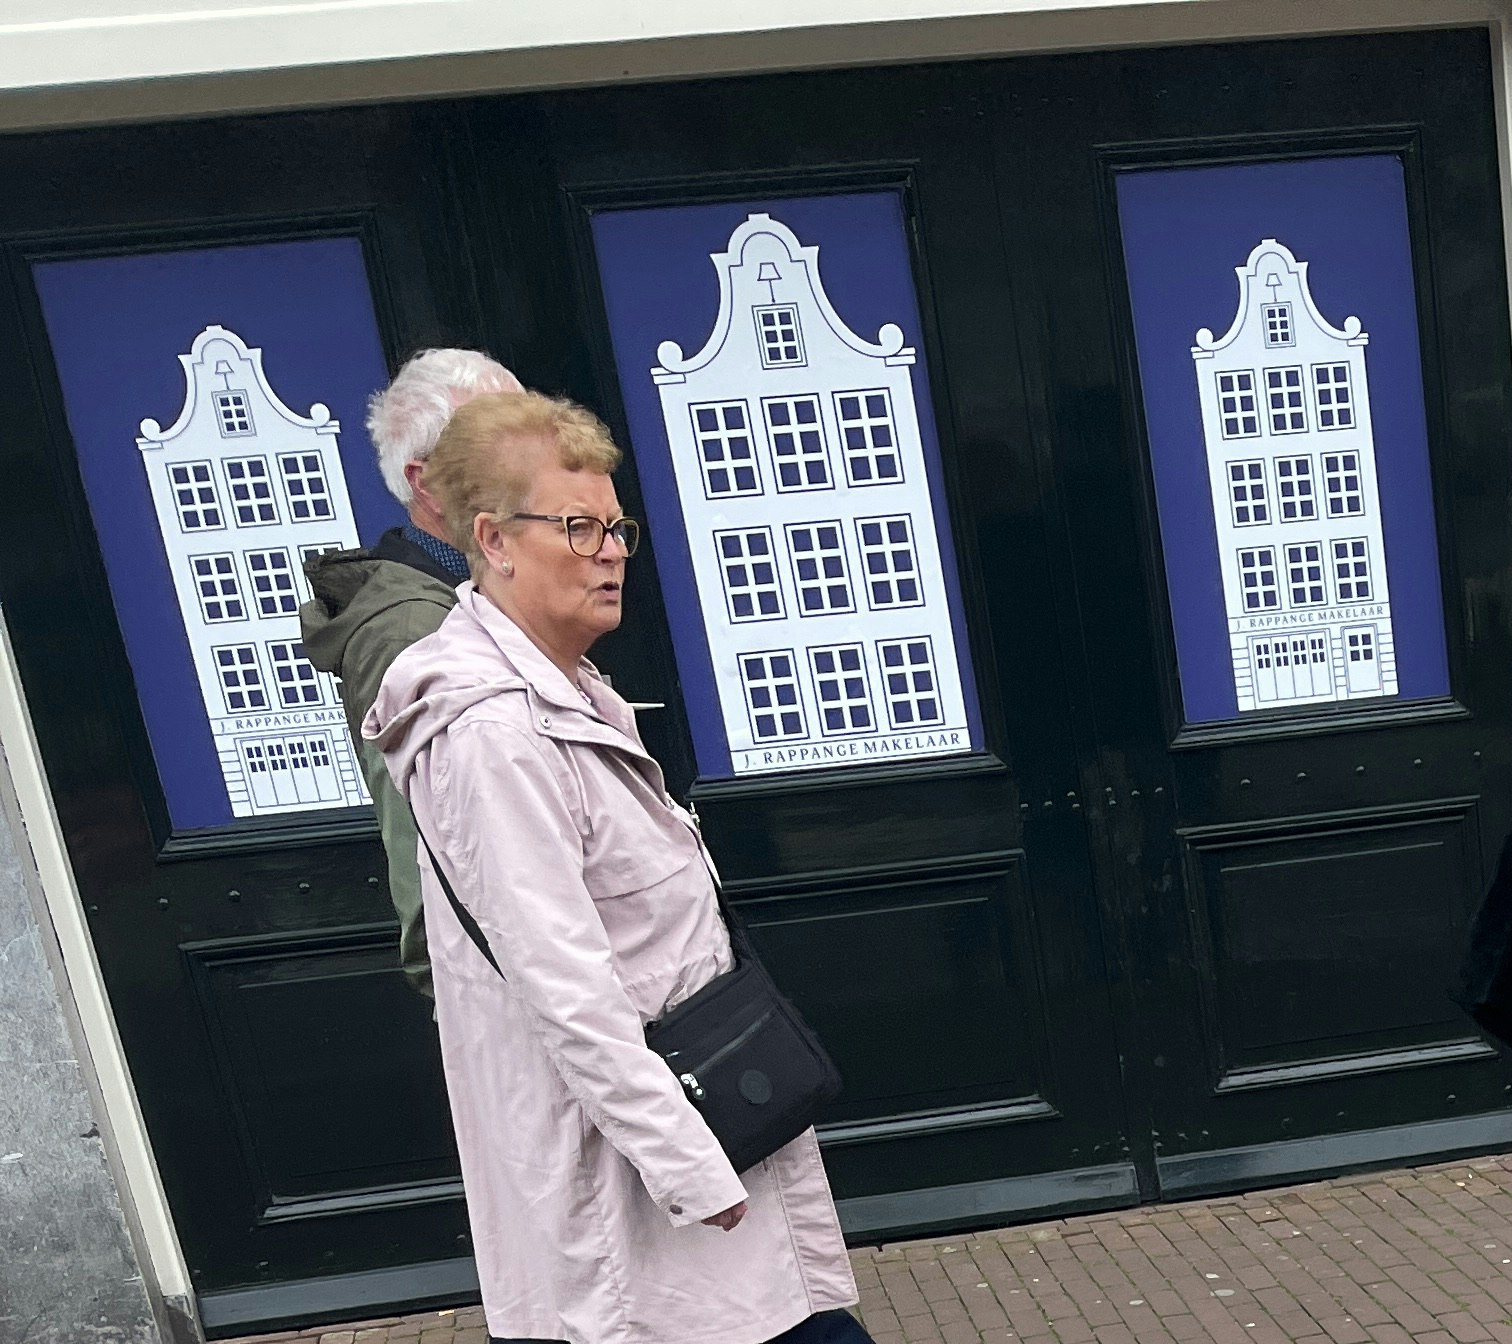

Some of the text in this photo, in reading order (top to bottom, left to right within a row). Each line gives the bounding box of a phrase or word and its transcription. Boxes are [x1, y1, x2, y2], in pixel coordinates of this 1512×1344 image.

[1250, 613, 1314, 628] RAPPANGE
[1318, 605, 1384, 621] MAKELAAR
[236, 713, 309, 730] RAPPANGE
[764, 743, 859, 764] RAPPANGE
[864, 732, 960, 754] MAKELAAR
